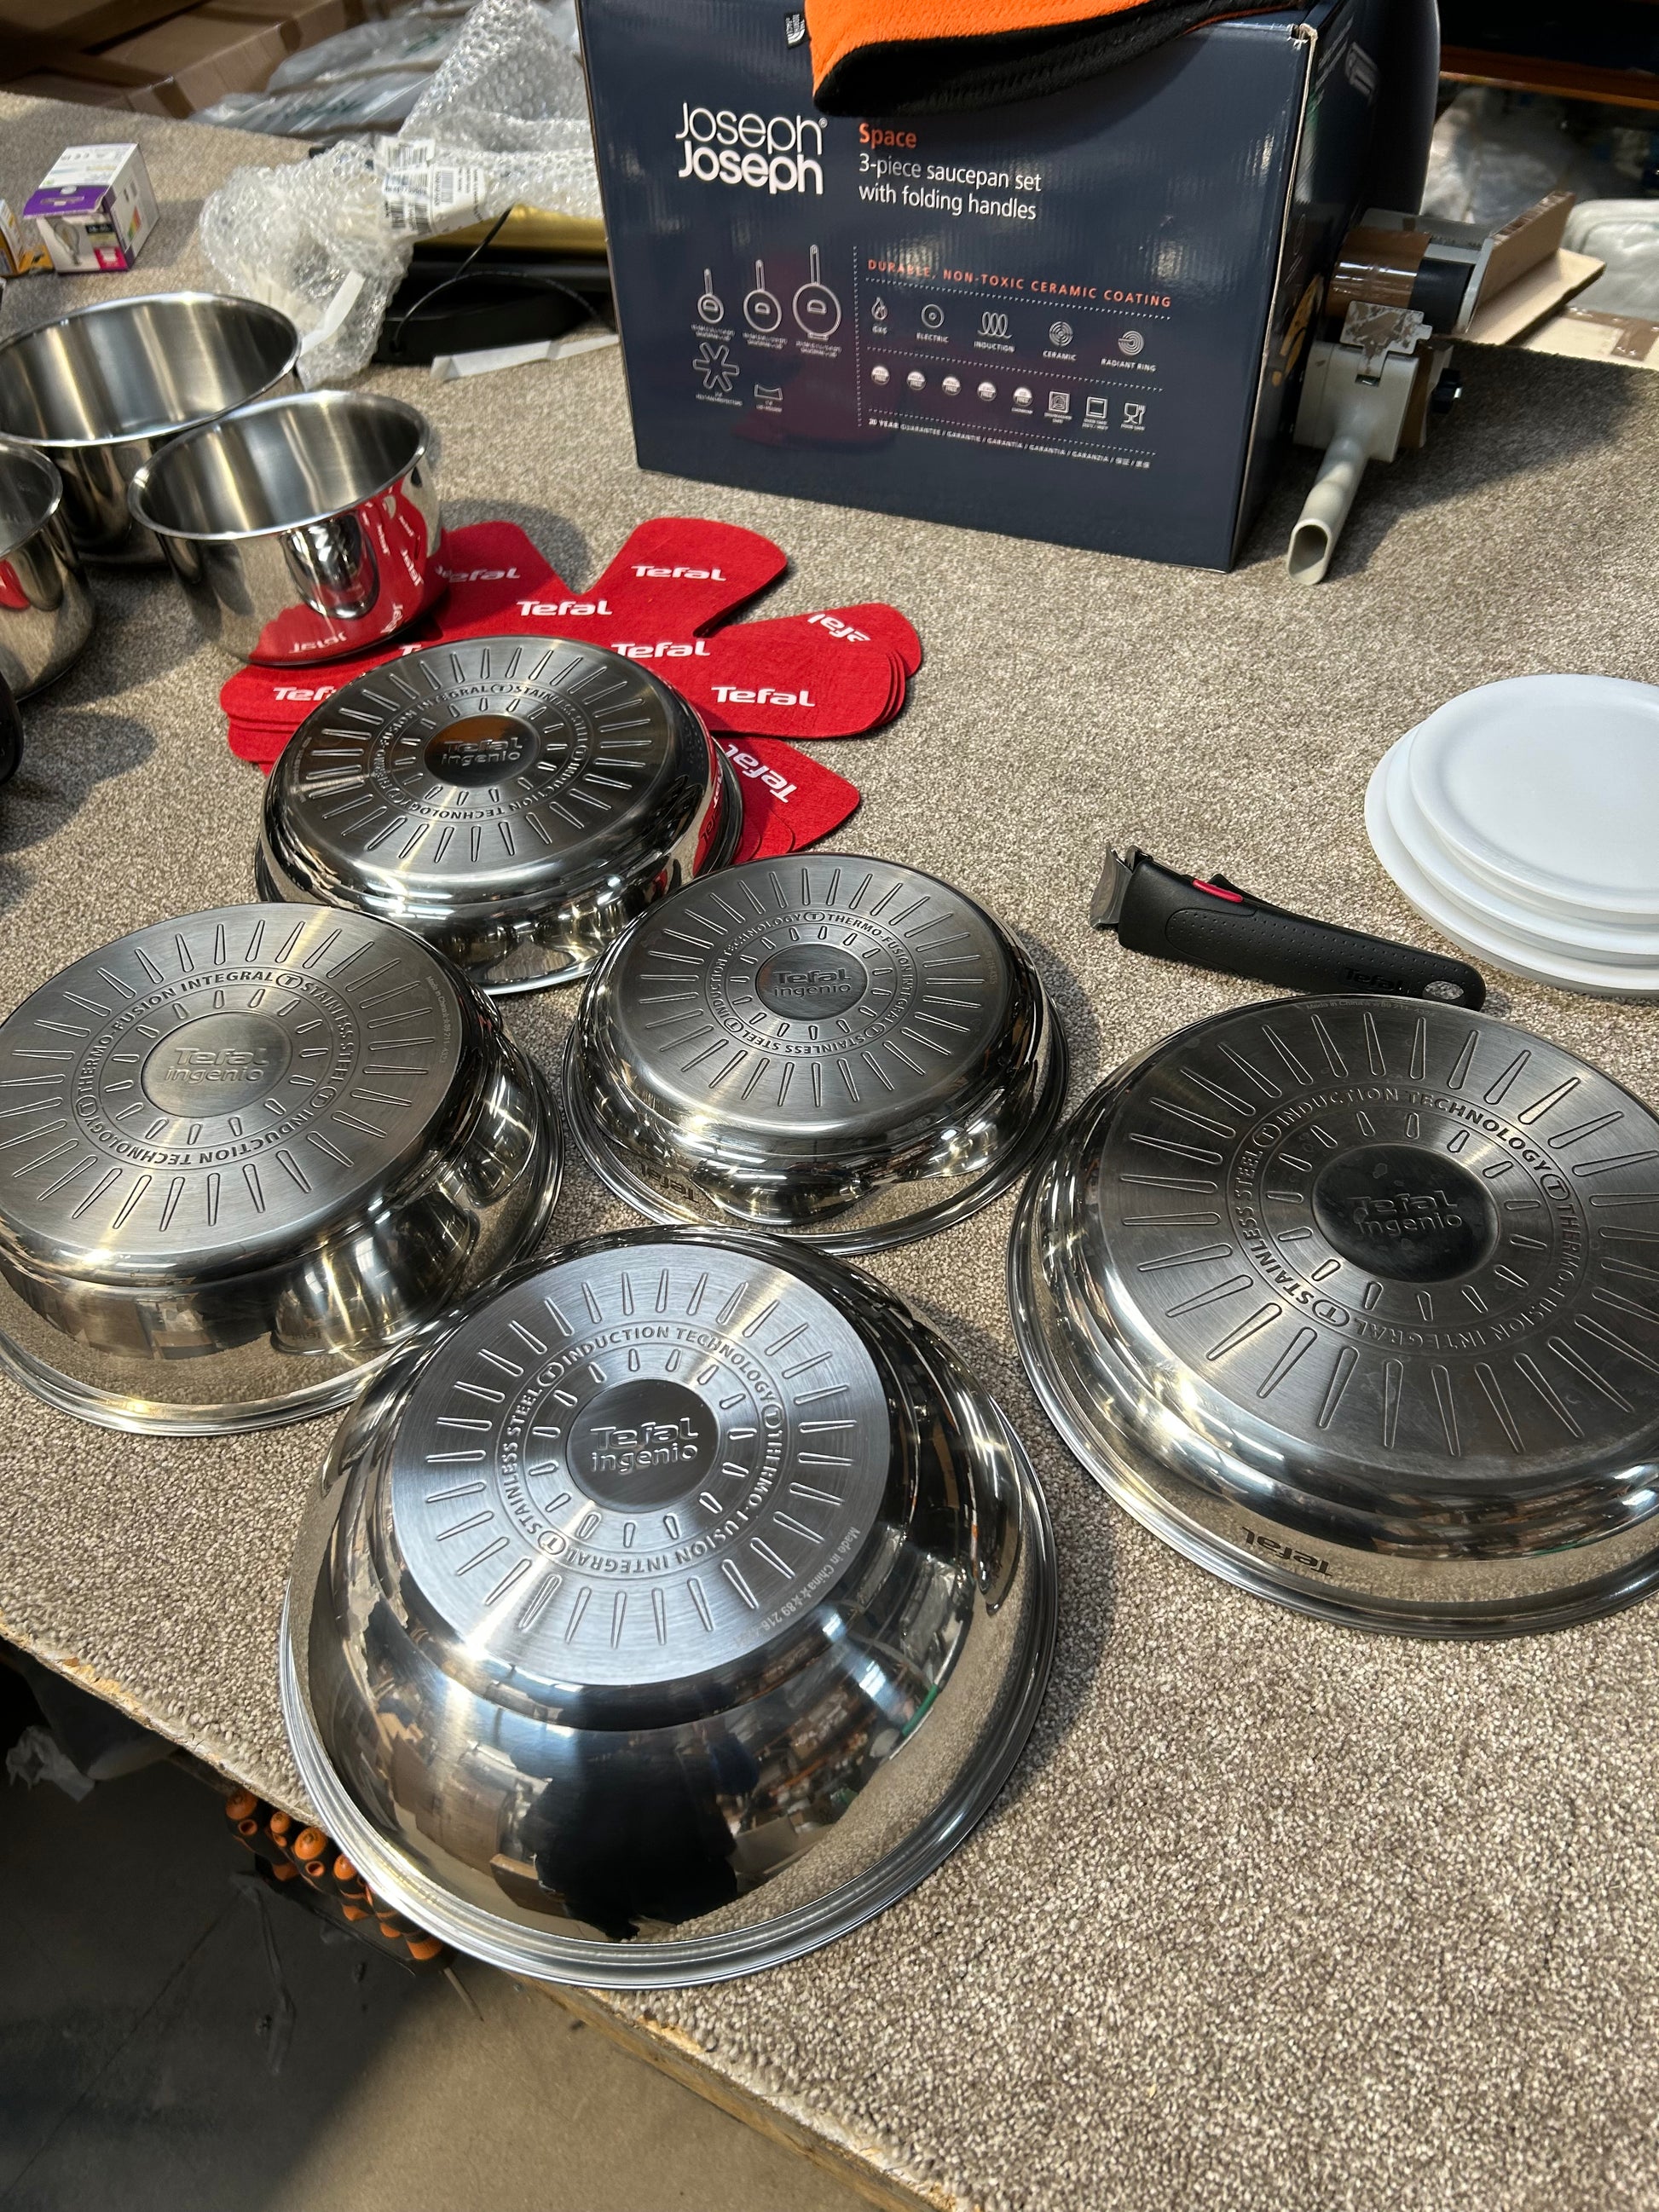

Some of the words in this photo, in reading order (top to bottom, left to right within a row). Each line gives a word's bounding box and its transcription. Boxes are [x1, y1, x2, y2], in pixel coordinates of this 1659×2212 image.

[859, 122, 917, 150] Space
[678, 140, 824, 195] Joseph
[859, 153, 922, 178] 3-piece
[927, 162, 1009, 191] saucepan
[1014, 170, 1042, 192] set
[859, 182, 897, 205] with
[902, 185, 962, 216] folding
[968, 193, 1037, 221] handles
[868, 258, 937, 280] DURABLE,
[943, 269, 1025, 290] NON-TOXIC
[1031, 280, 1097, 299] CERAMIC
[1103, 290, 1172, 309] COATING
[916, 332, 950, 344] ELECTRIC
[974, 341, 1015, 353] INDUCTION
[1043, 349, 1077, 361] CERAMIC
[1101, 358, 1136, 370] RADIANT
[1136, 362, 1157, 373] RING
[447, 567, 521, 583] efal
[632, 565, 726, 581] Tefal
[517, 599, 613, 616] Tefal
[611, 641, 710, 659] Tefal
[273, 686, 337, 702] Tef
[712, 686, 816, 707] Tefal
[441, 750, 521, 766] ingenio
[725, 743, 798, 803] Tefal
[828, 913, 912, 972] THERMO-FUSION
[181, 971, 273, 992] INTEGRAL
[773, 969, 852, 984] Tefal
[774, 983, 851, 997] ingenio
[78, 988, 176, 1094] THERMO-FUSION
[743, 1031, 779, 1050] STEEL
[785, 1034, 866, 1054] STAINLESS
[175, 1048, 269, 1066] Tefal
[165, 1066, 264, 1084] ingenio
[1279, 1088, 1399, 1126] INDUCTION
[85, 1118, 191, 1165] TECHNOLOGY
[199, 1109, 314, 1162] INDUCTION
[1405, 1091, 1552, 1171] TECHNOLOGY
[1234, 1150, 1263, 1199] STEEL
[1235, 1206, 1314, 1305] STAINLESS
[563, 1326, 669, 1365] INDUCTION
[677, 1327, 775, 1401] TECHNOLOGY
[507, 1388, 543, 1437] STEEL
[591, 1417, 699, 1450] Tefal
[591, 1444, 698, 1473] ingenio
[501, 1442, 546, 1534] STAINLESS
[838, 1527, 860, 1553] Made
[1242, 1526, 1332, 1576] Tefal
[566, 1548, 669, 1573] INTEGRAL
